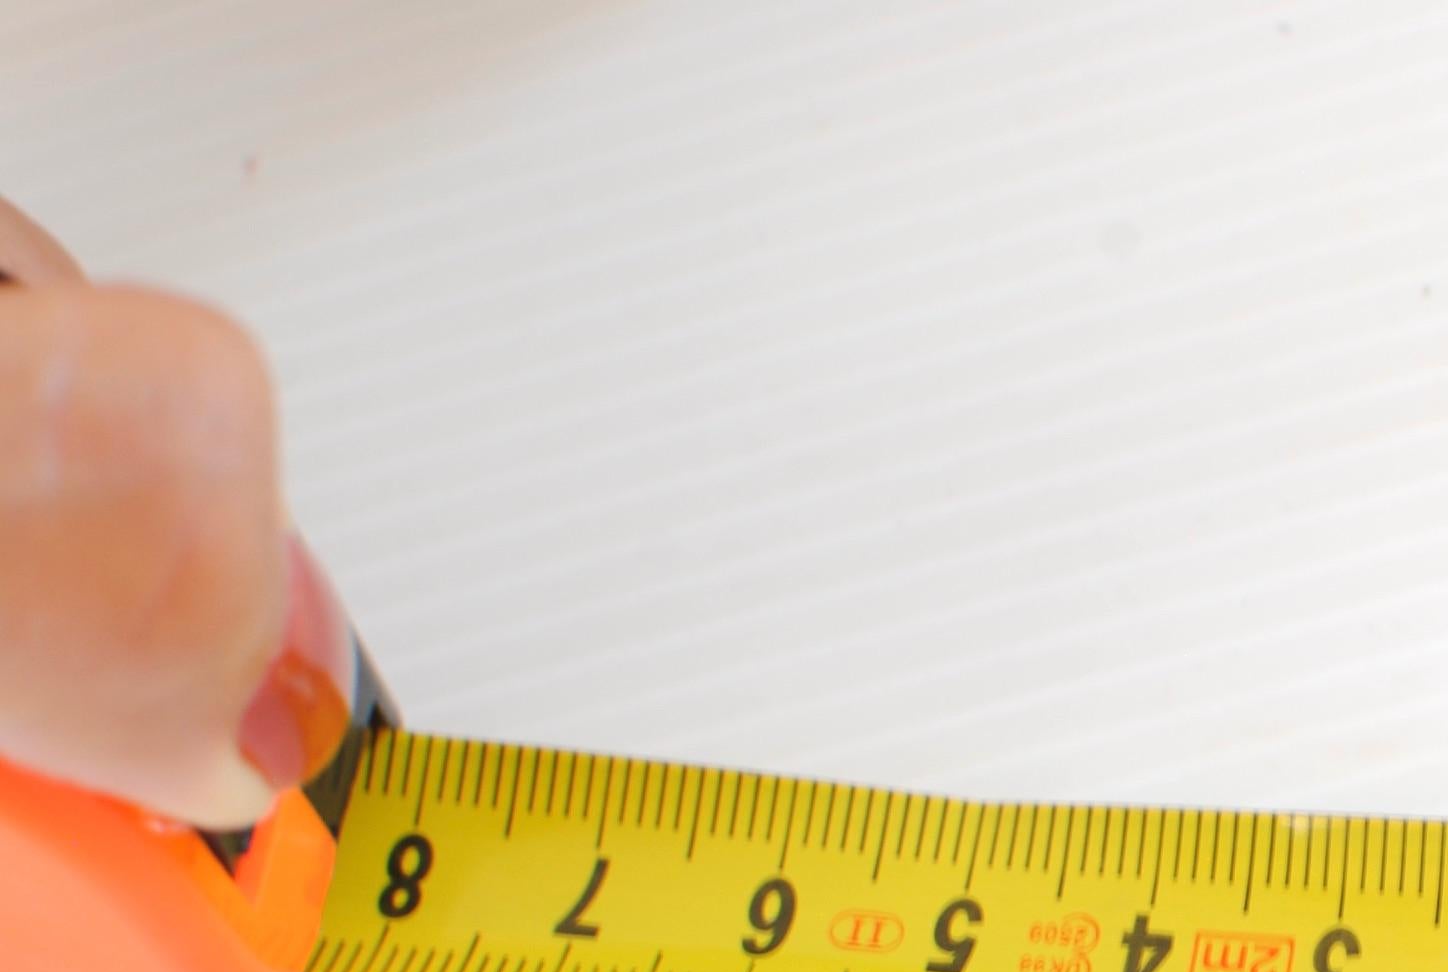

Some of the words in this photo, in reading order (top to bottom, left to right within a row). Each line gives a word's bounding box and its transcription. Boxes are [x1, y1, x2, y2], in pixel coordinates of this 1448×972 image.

[378, 834, 433, 918] 8
[553, 857, 610, 938] 7
[742, 877, 796, 955] 6
